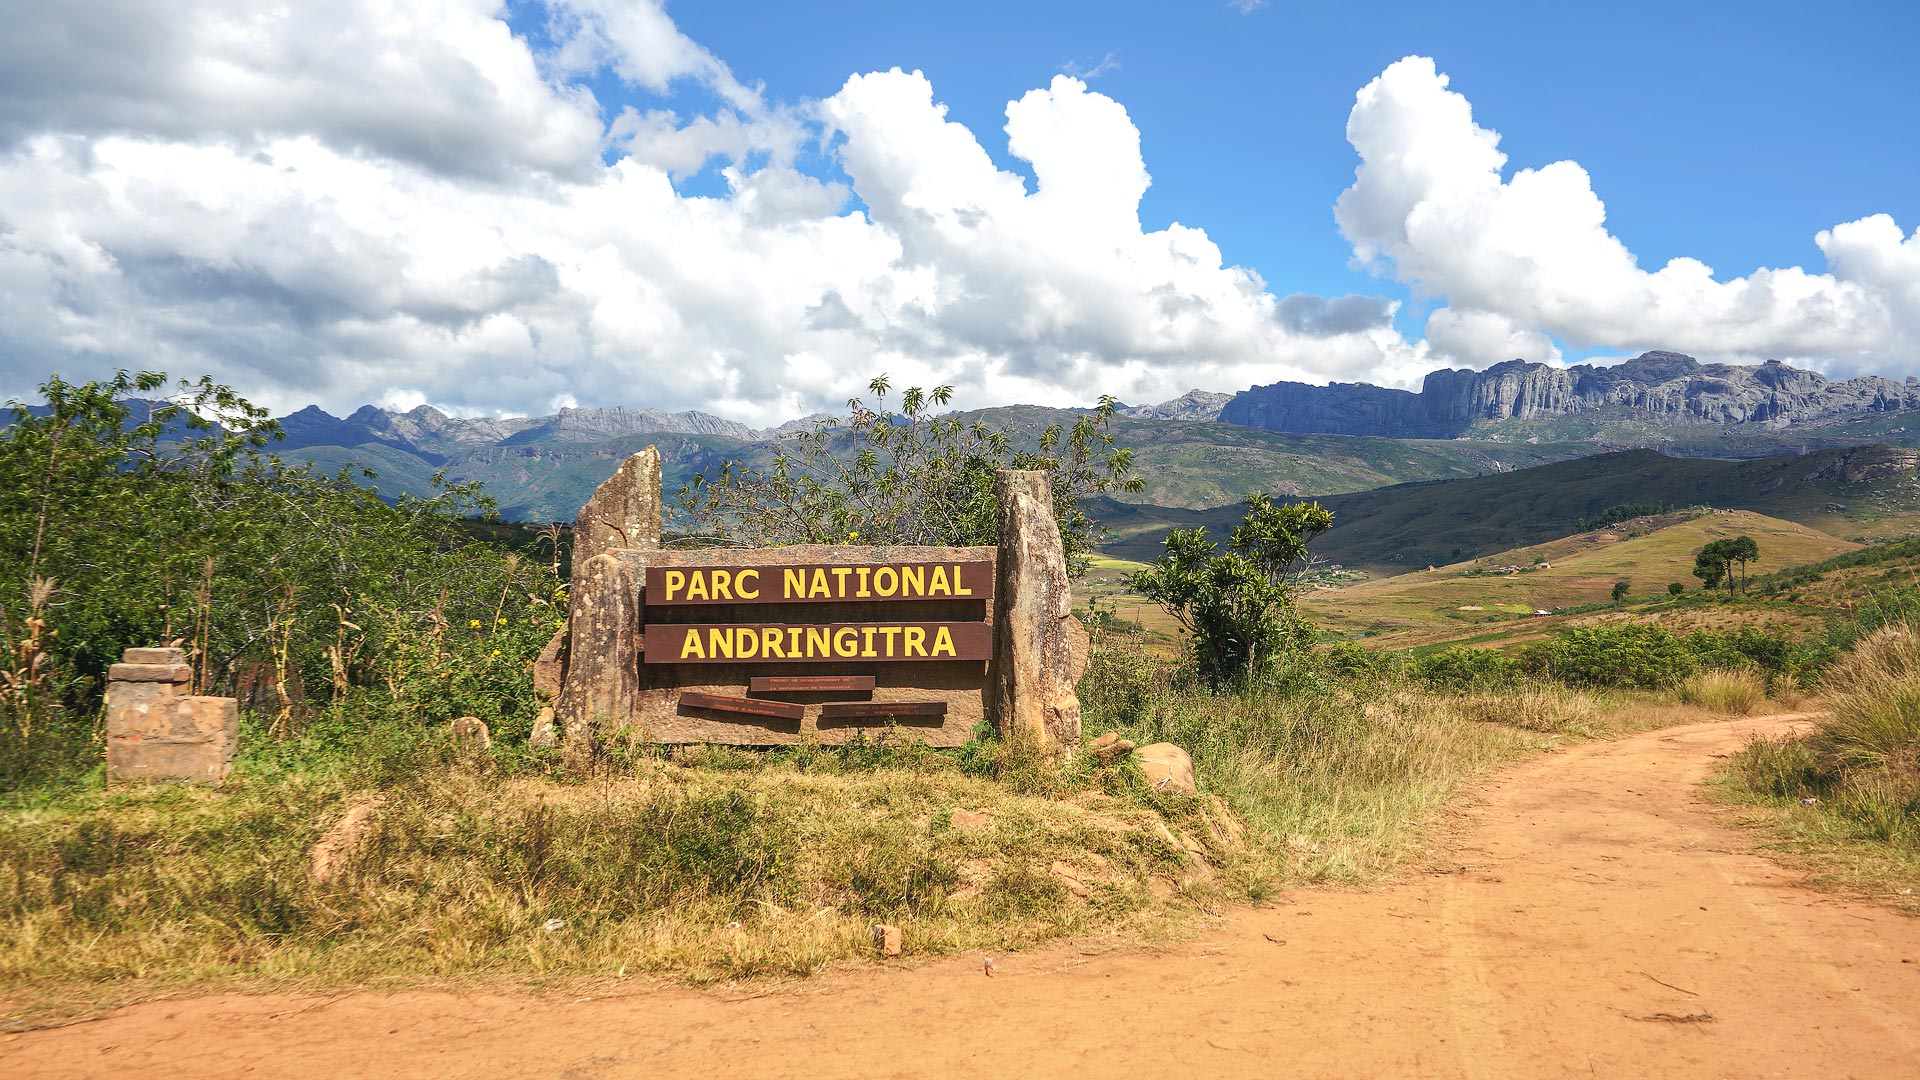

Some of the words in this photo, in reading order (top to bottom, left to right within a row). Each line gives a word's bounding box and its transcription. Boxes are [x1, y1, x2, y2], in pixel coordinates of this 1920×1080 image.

[665, 569, 760, 601] PARC
[783, 565, 972, 599] NATIONAL
[680, 626, 957, 659] ANDRINGITRA
